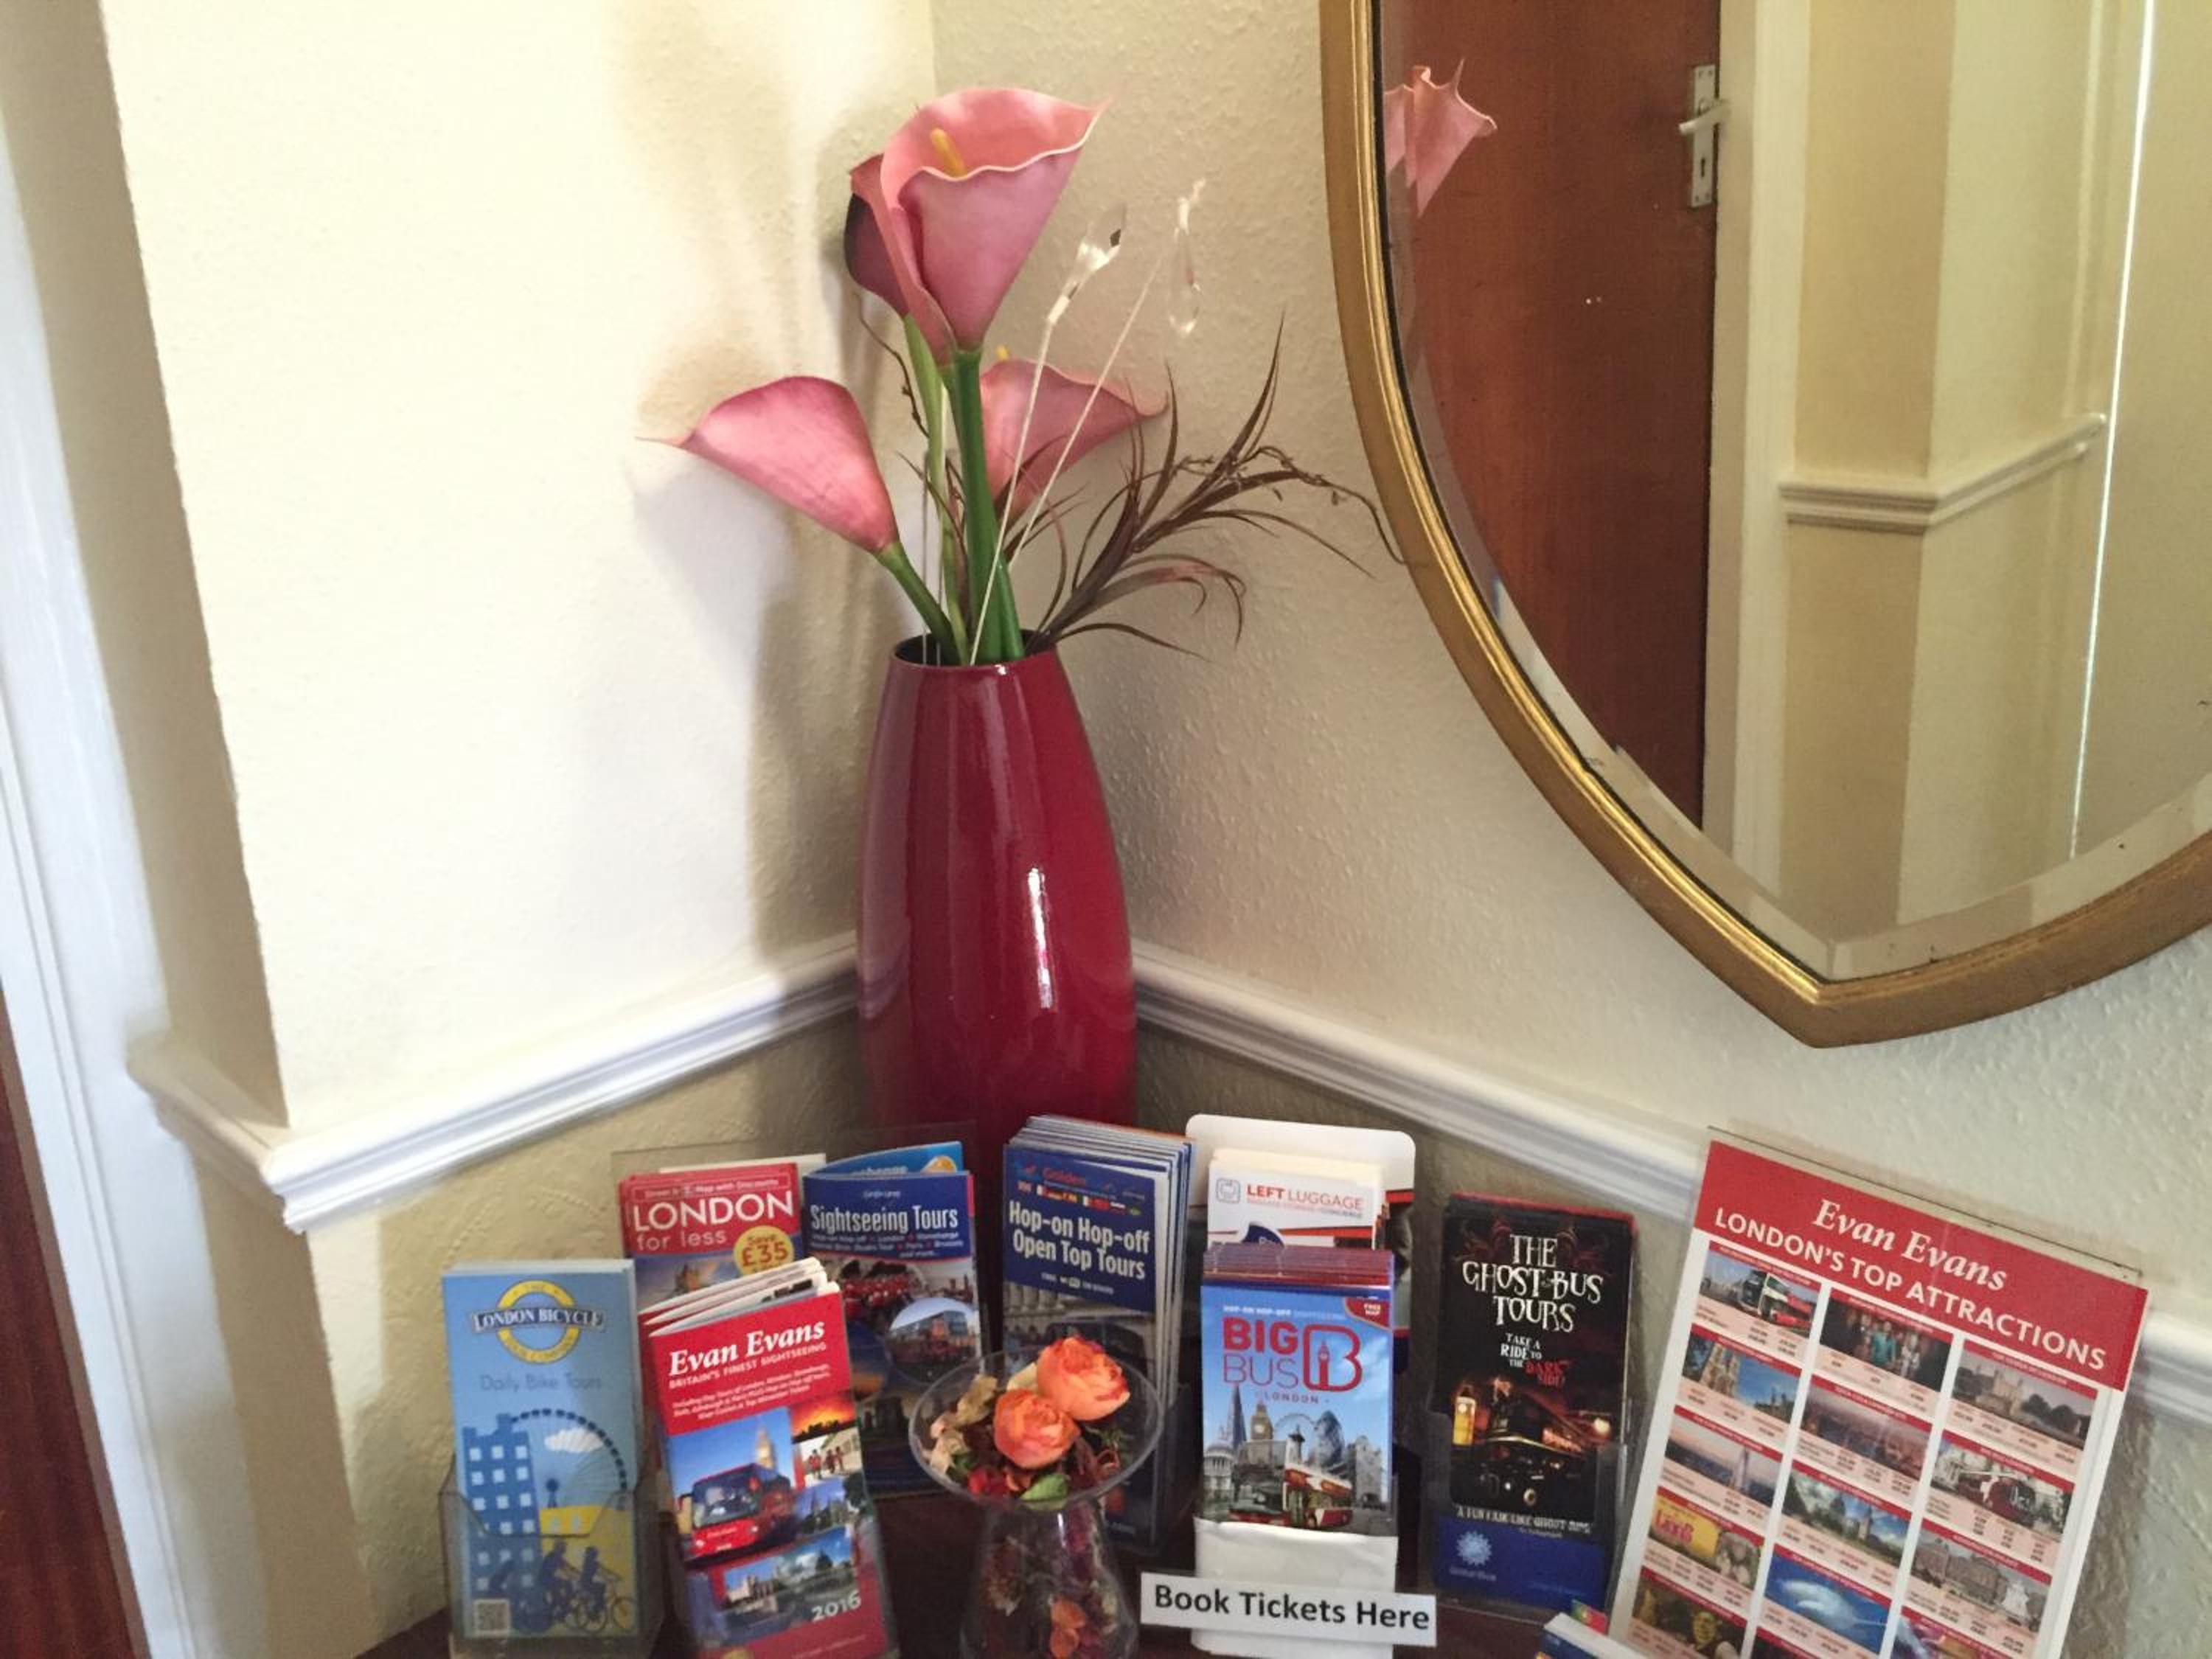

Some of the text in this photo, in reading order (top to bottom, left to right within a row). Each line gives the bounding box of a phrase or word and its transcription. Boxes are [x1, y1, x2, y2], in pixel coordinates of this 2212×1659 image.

[633, 1190, 794, 1232] LONDON
[1247, 1184, 1284, 1200] LEFT
[1288, 1189, 1363, 1210] LUGGAGE
[810, 1204, 959, 1234] Sightseeing Tours
[1009, 1200, 1150, 1253] Hop-on Hop-off
[636, 1229, 728, 1251] for less
[742, 1241, 788, 1267] £35
[1013, 1229, 1145, 1280] Open Top Tours
[1509, 1234, 1557, 1268] THE
[1812, 1199, 2007, 1290] Evan Evans
[1462, 1261, 1604, 1304] GHOST BUS
[1715, 1207, 1845, 1272] LONDON'S
[1850, 1256, 1902, 1291] TOP
[1905, 1281, 2107, 1371] ATTRACTIONS
[473, 1307, 536, 1332] LONDON
[1493, 1295, 1576, 1332] TOURS
[668, 1321, 825, 1376] Evan Evans
[1222, 1316, 1298, 1355] BIG
[1500, 1343, 1543, 1360] RIDE TO
[1506, 1332, 1532, 1351] TAKE
[723, 1360, 757, 1377] FINEST
[1222, 1352, 1299, 1389] BUS
[1263, 1391, 1319, 1404] LONDON
[812, 1590, 862, 1621] 2016
[1154, 1584, 1430, 1630] Book Tickets Here
